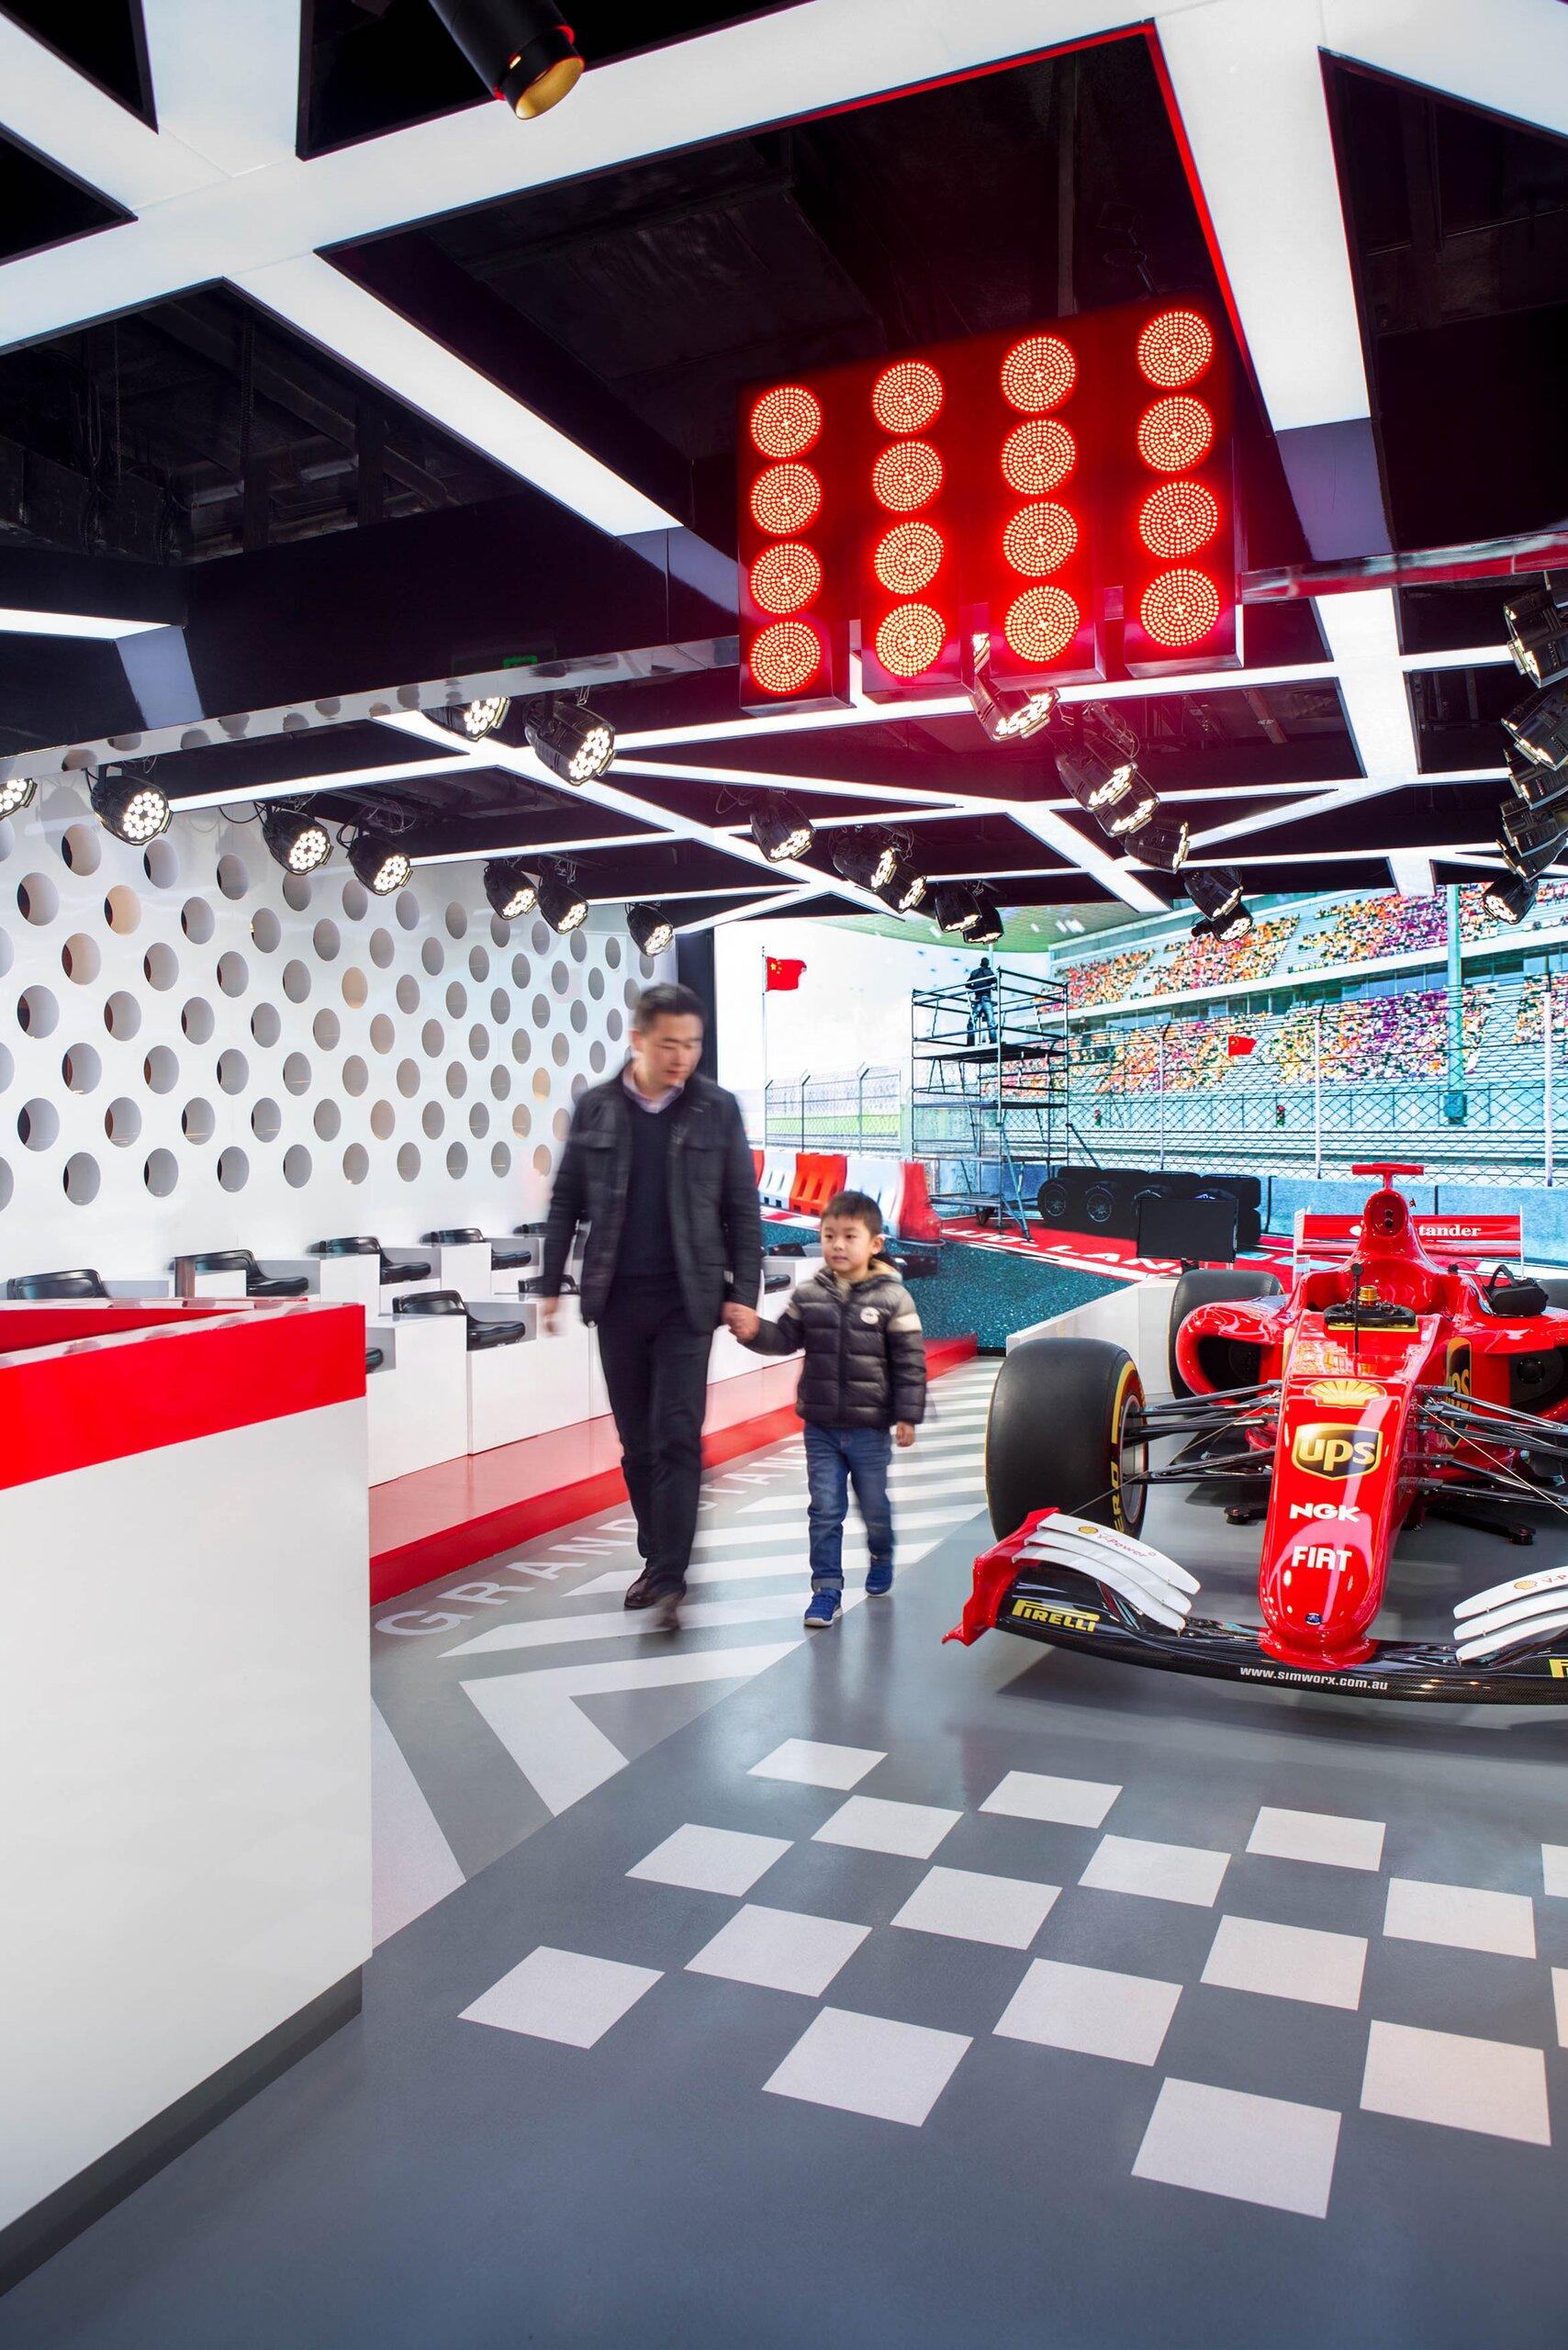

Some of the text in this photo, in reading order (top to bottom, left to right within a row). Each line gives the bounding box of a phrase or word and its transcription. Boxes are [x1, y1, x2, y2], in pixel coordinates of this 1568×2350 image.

[1419, 1224, 1482, 1237] tander
[1297, 1438, 1376, 1472] ups
[1110, 1460, 1126, 1533] ERO
[1289, 1503, 1361, 1523] NGK
[1291, 1546, 1352, 1572] FIAT
[1012, 1598, 1101, 1633] PIRELLI
[1239, 1666, 1389, 1691] www.simworx.com.au
